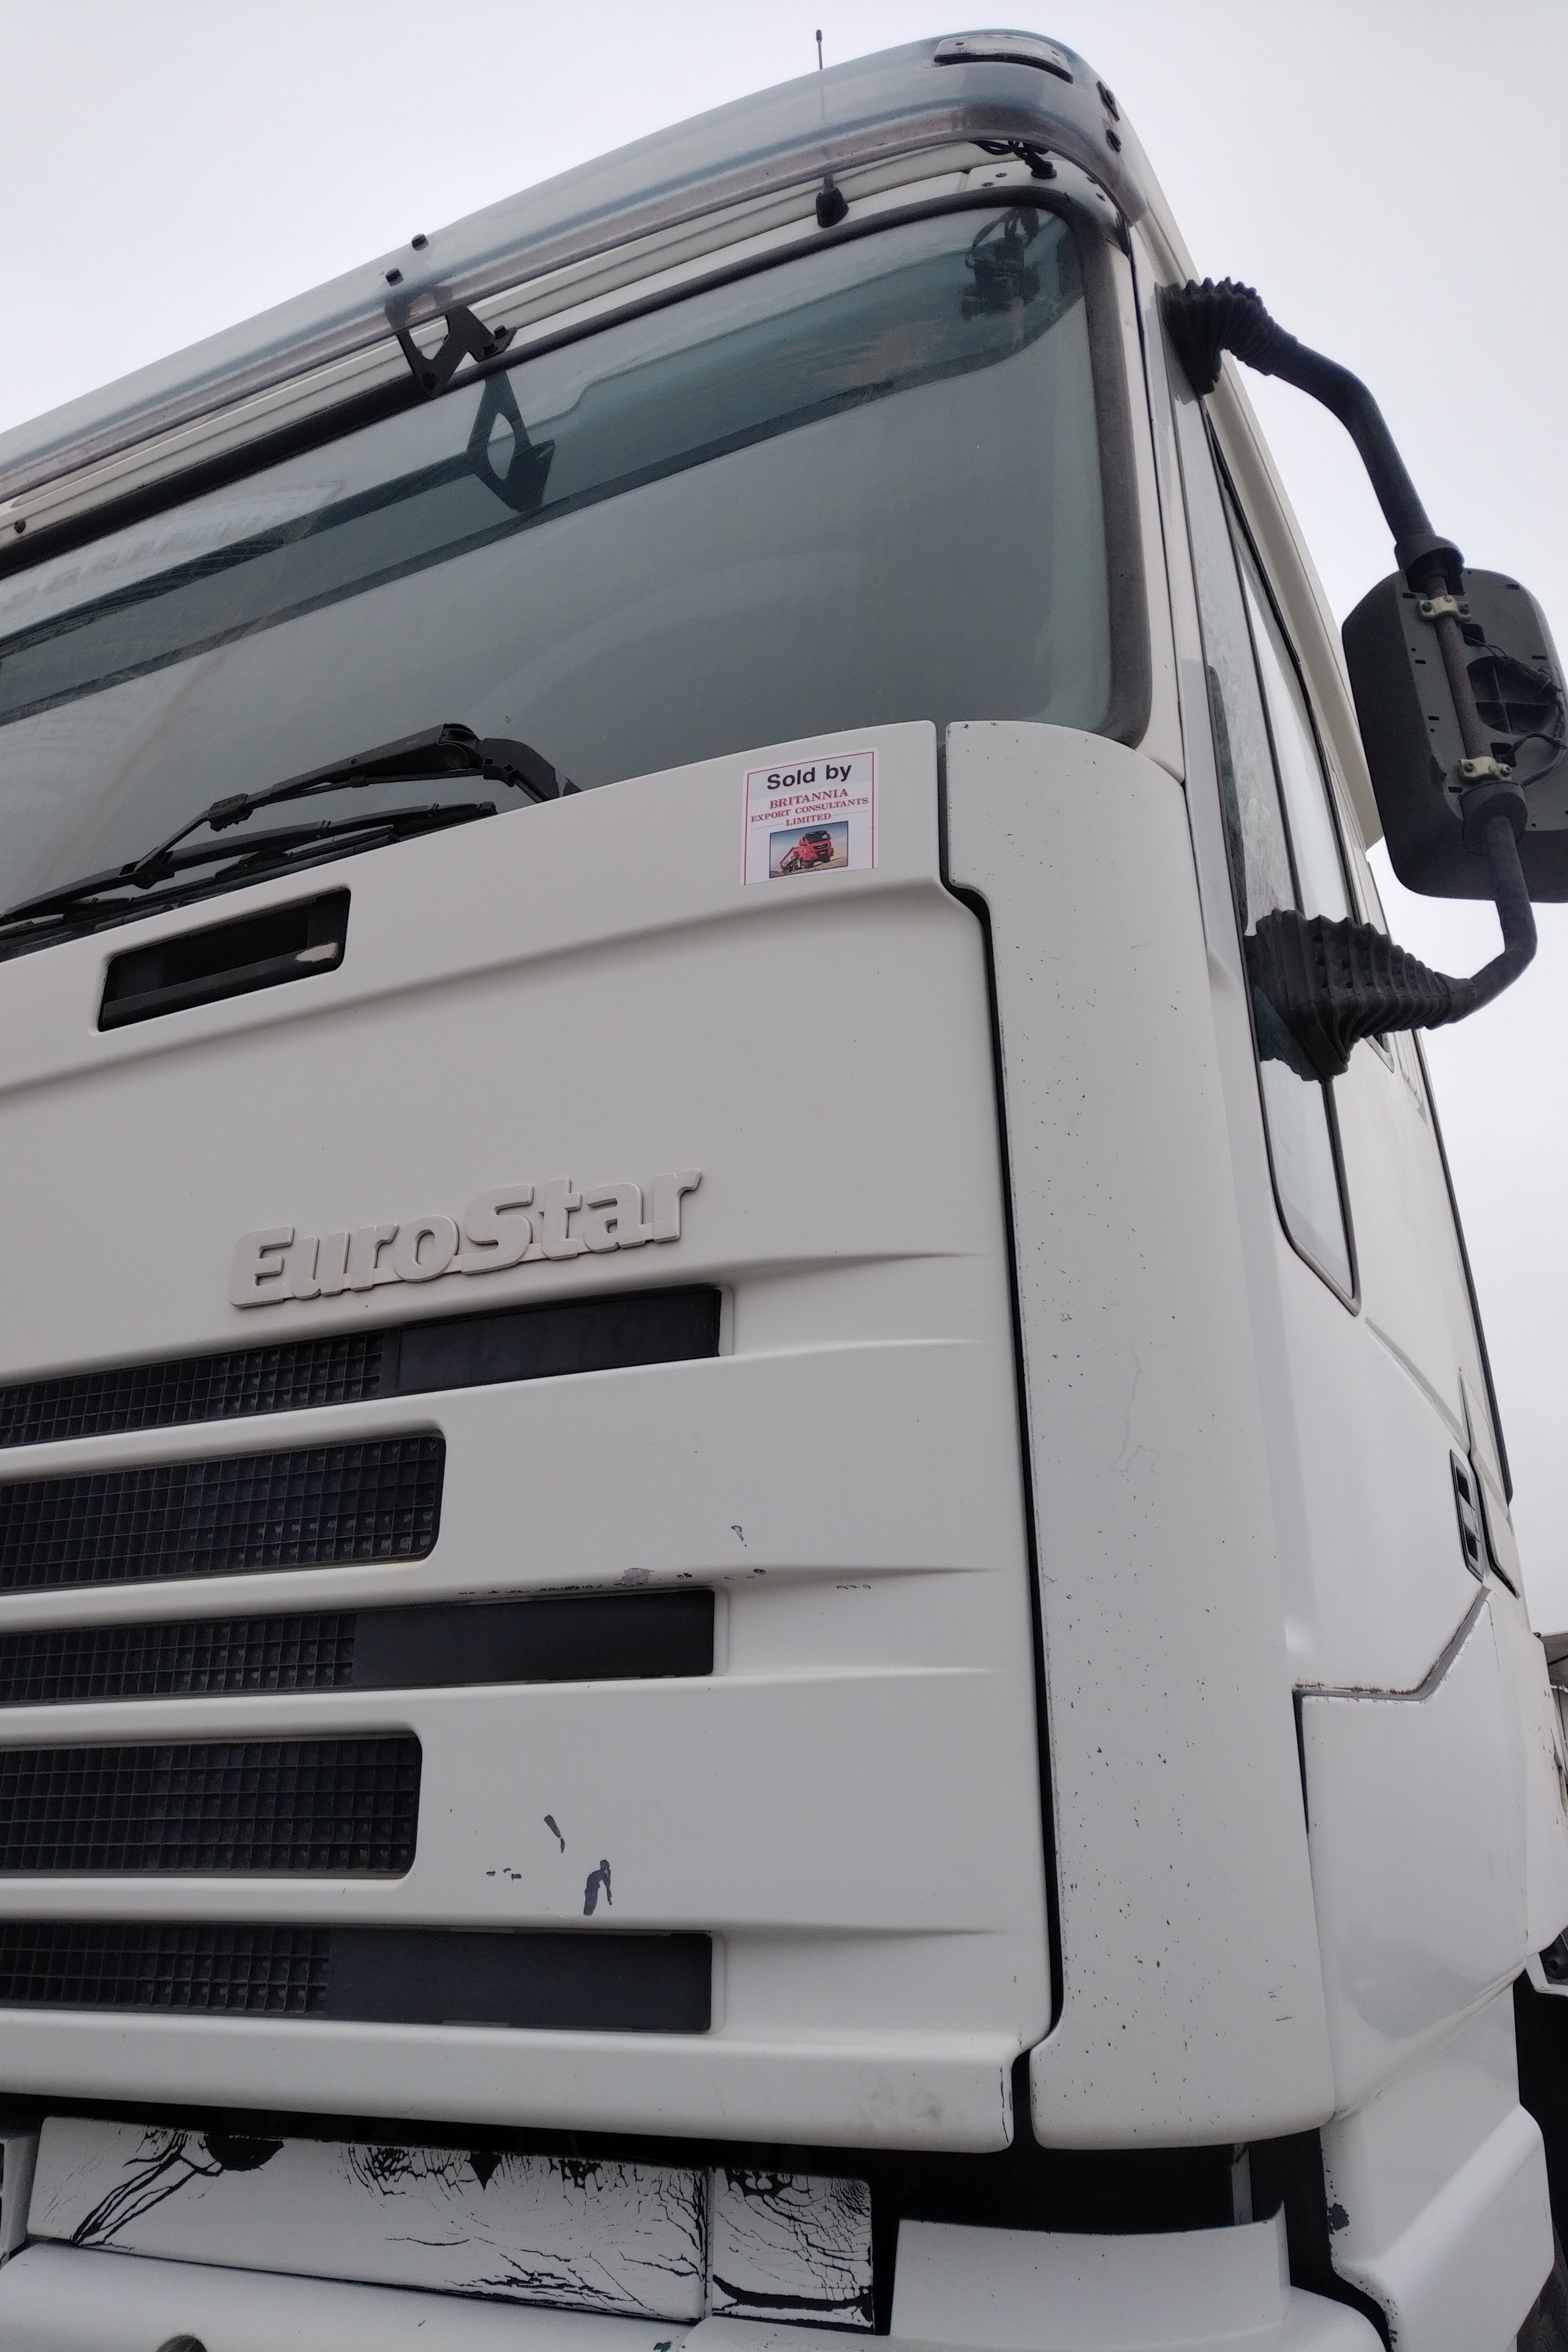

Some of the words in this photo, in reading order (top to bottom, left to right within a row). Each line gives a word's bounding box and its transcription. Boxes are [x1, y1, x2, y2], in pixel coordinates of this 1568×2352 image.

[767, 767, 815, 790] Sold
[826, 765, 852, 782] by
[750, 809, 791, 822] EXPORT
[795, 797, 869, 814] CONSULTANTS
[770, 788, 849, 809] BRITANNIA
[786, 812, 832, 826] LIMITED
[230, 1168, 702, 1308] EuroStar
